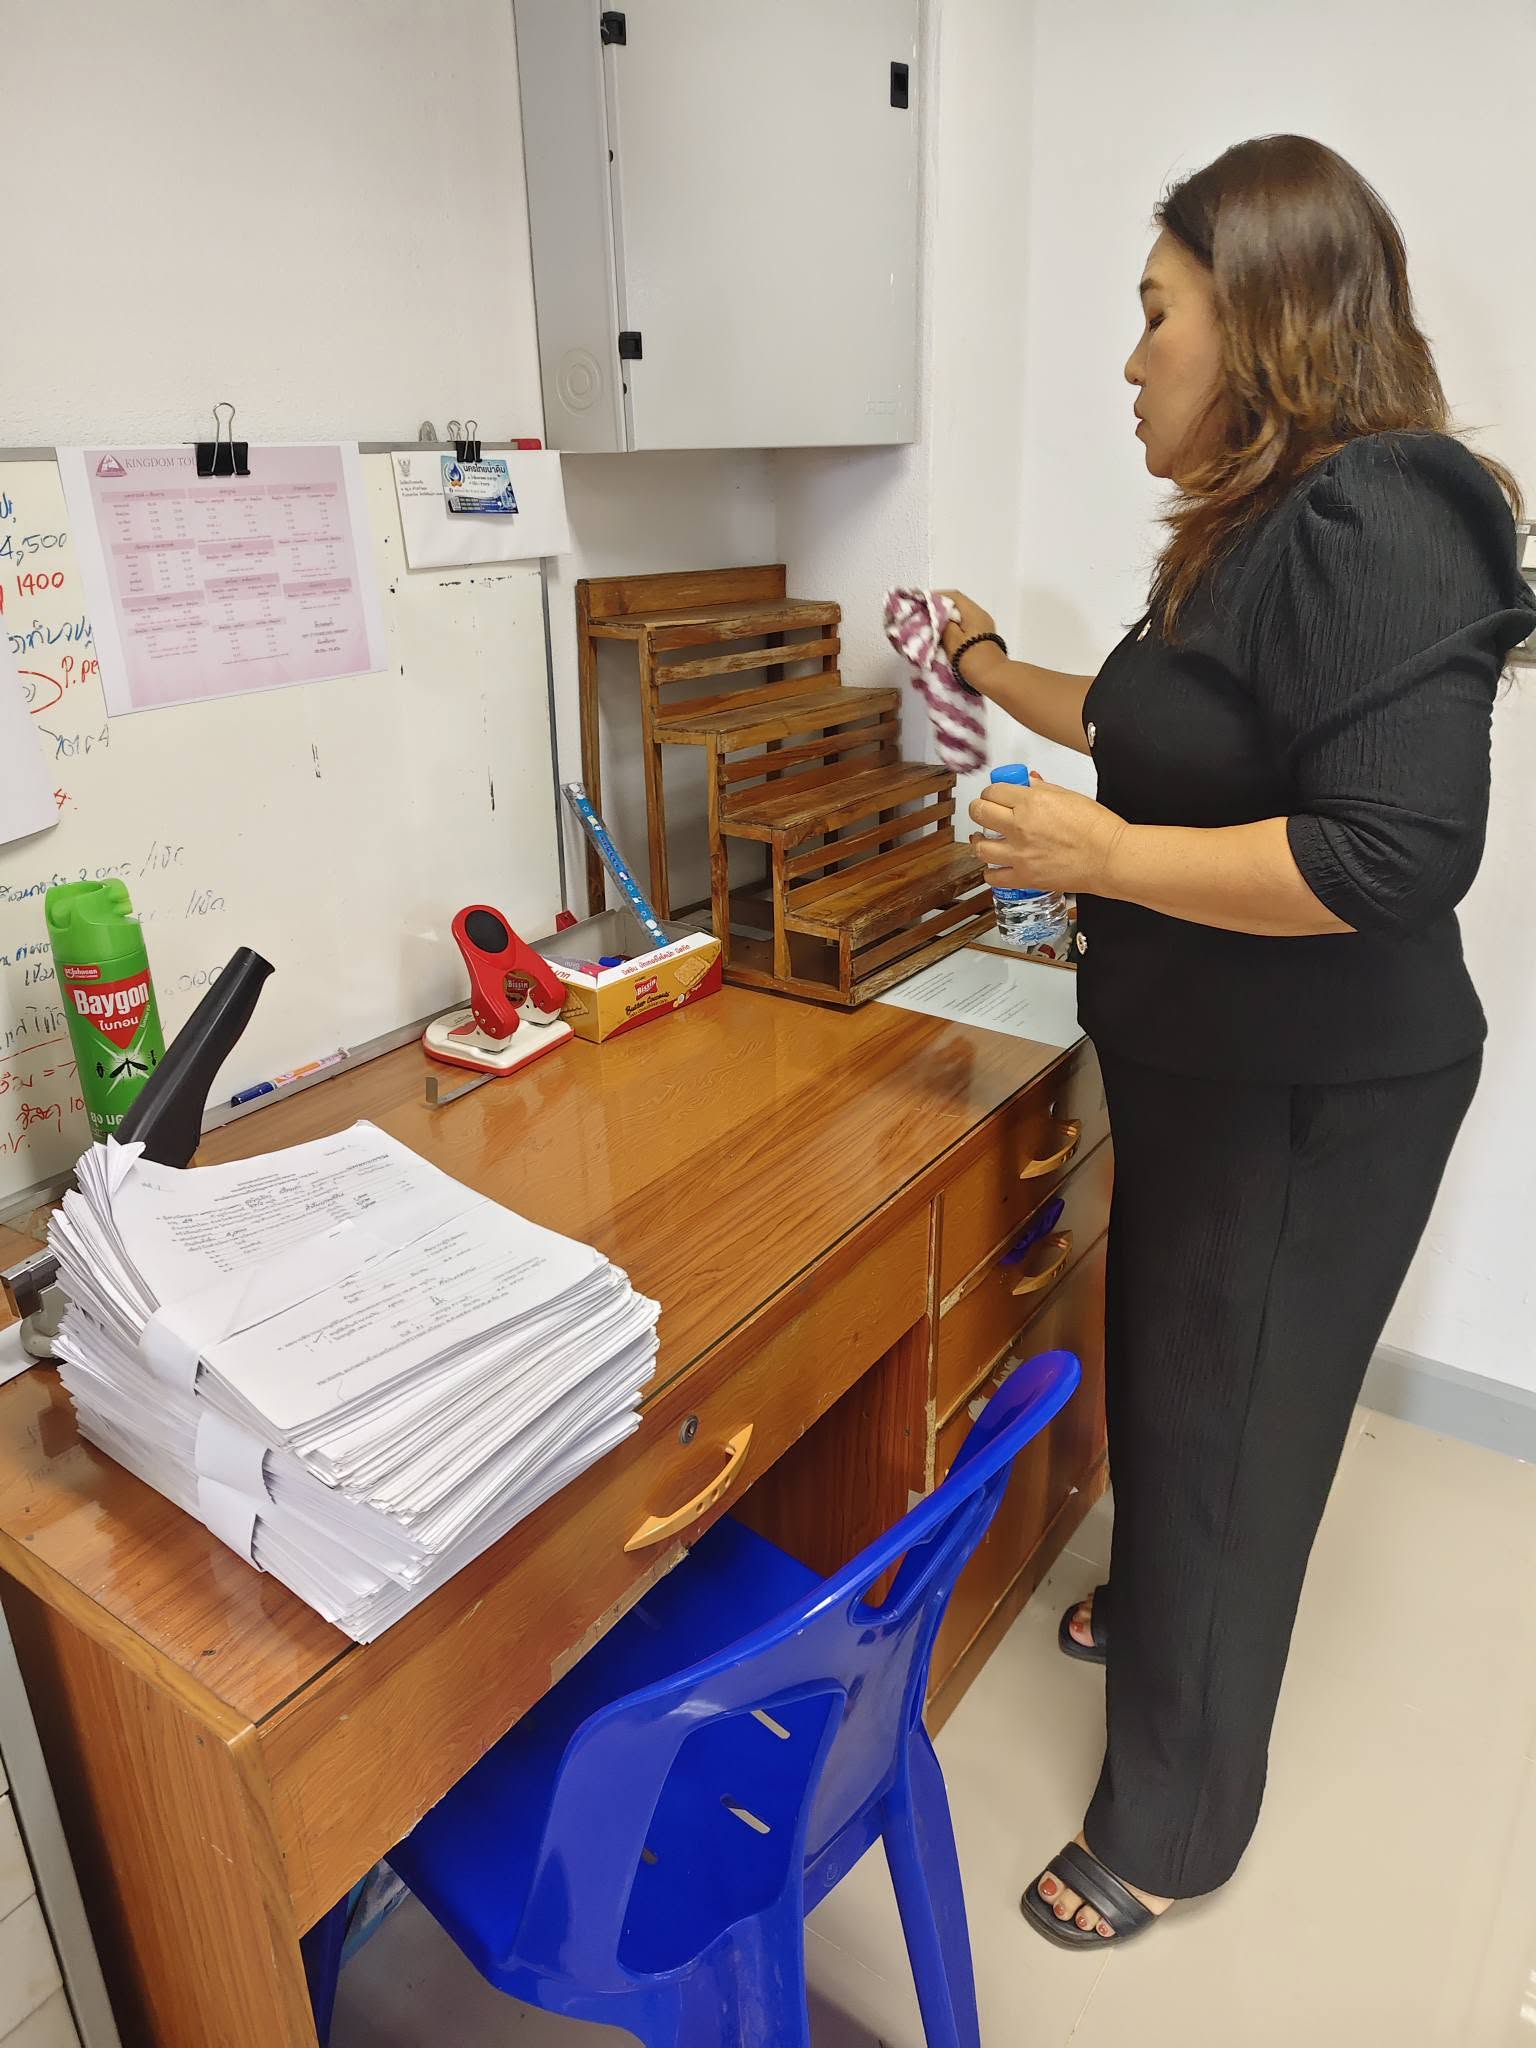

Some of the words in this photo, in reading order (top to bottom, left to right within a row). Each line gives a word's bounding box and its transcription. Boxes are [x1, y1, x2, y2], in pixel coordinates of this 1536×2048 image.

[125, 455, 175, 468] KINGDOM
[16, 571, 65, 597] 1400
[507, 979, 529, 990] Bissin
[636, 978, 658, 996] Bissin
[72, 982, 150, 1019] Baygon
[98, 1016, 140, 1032] ไบกอน
